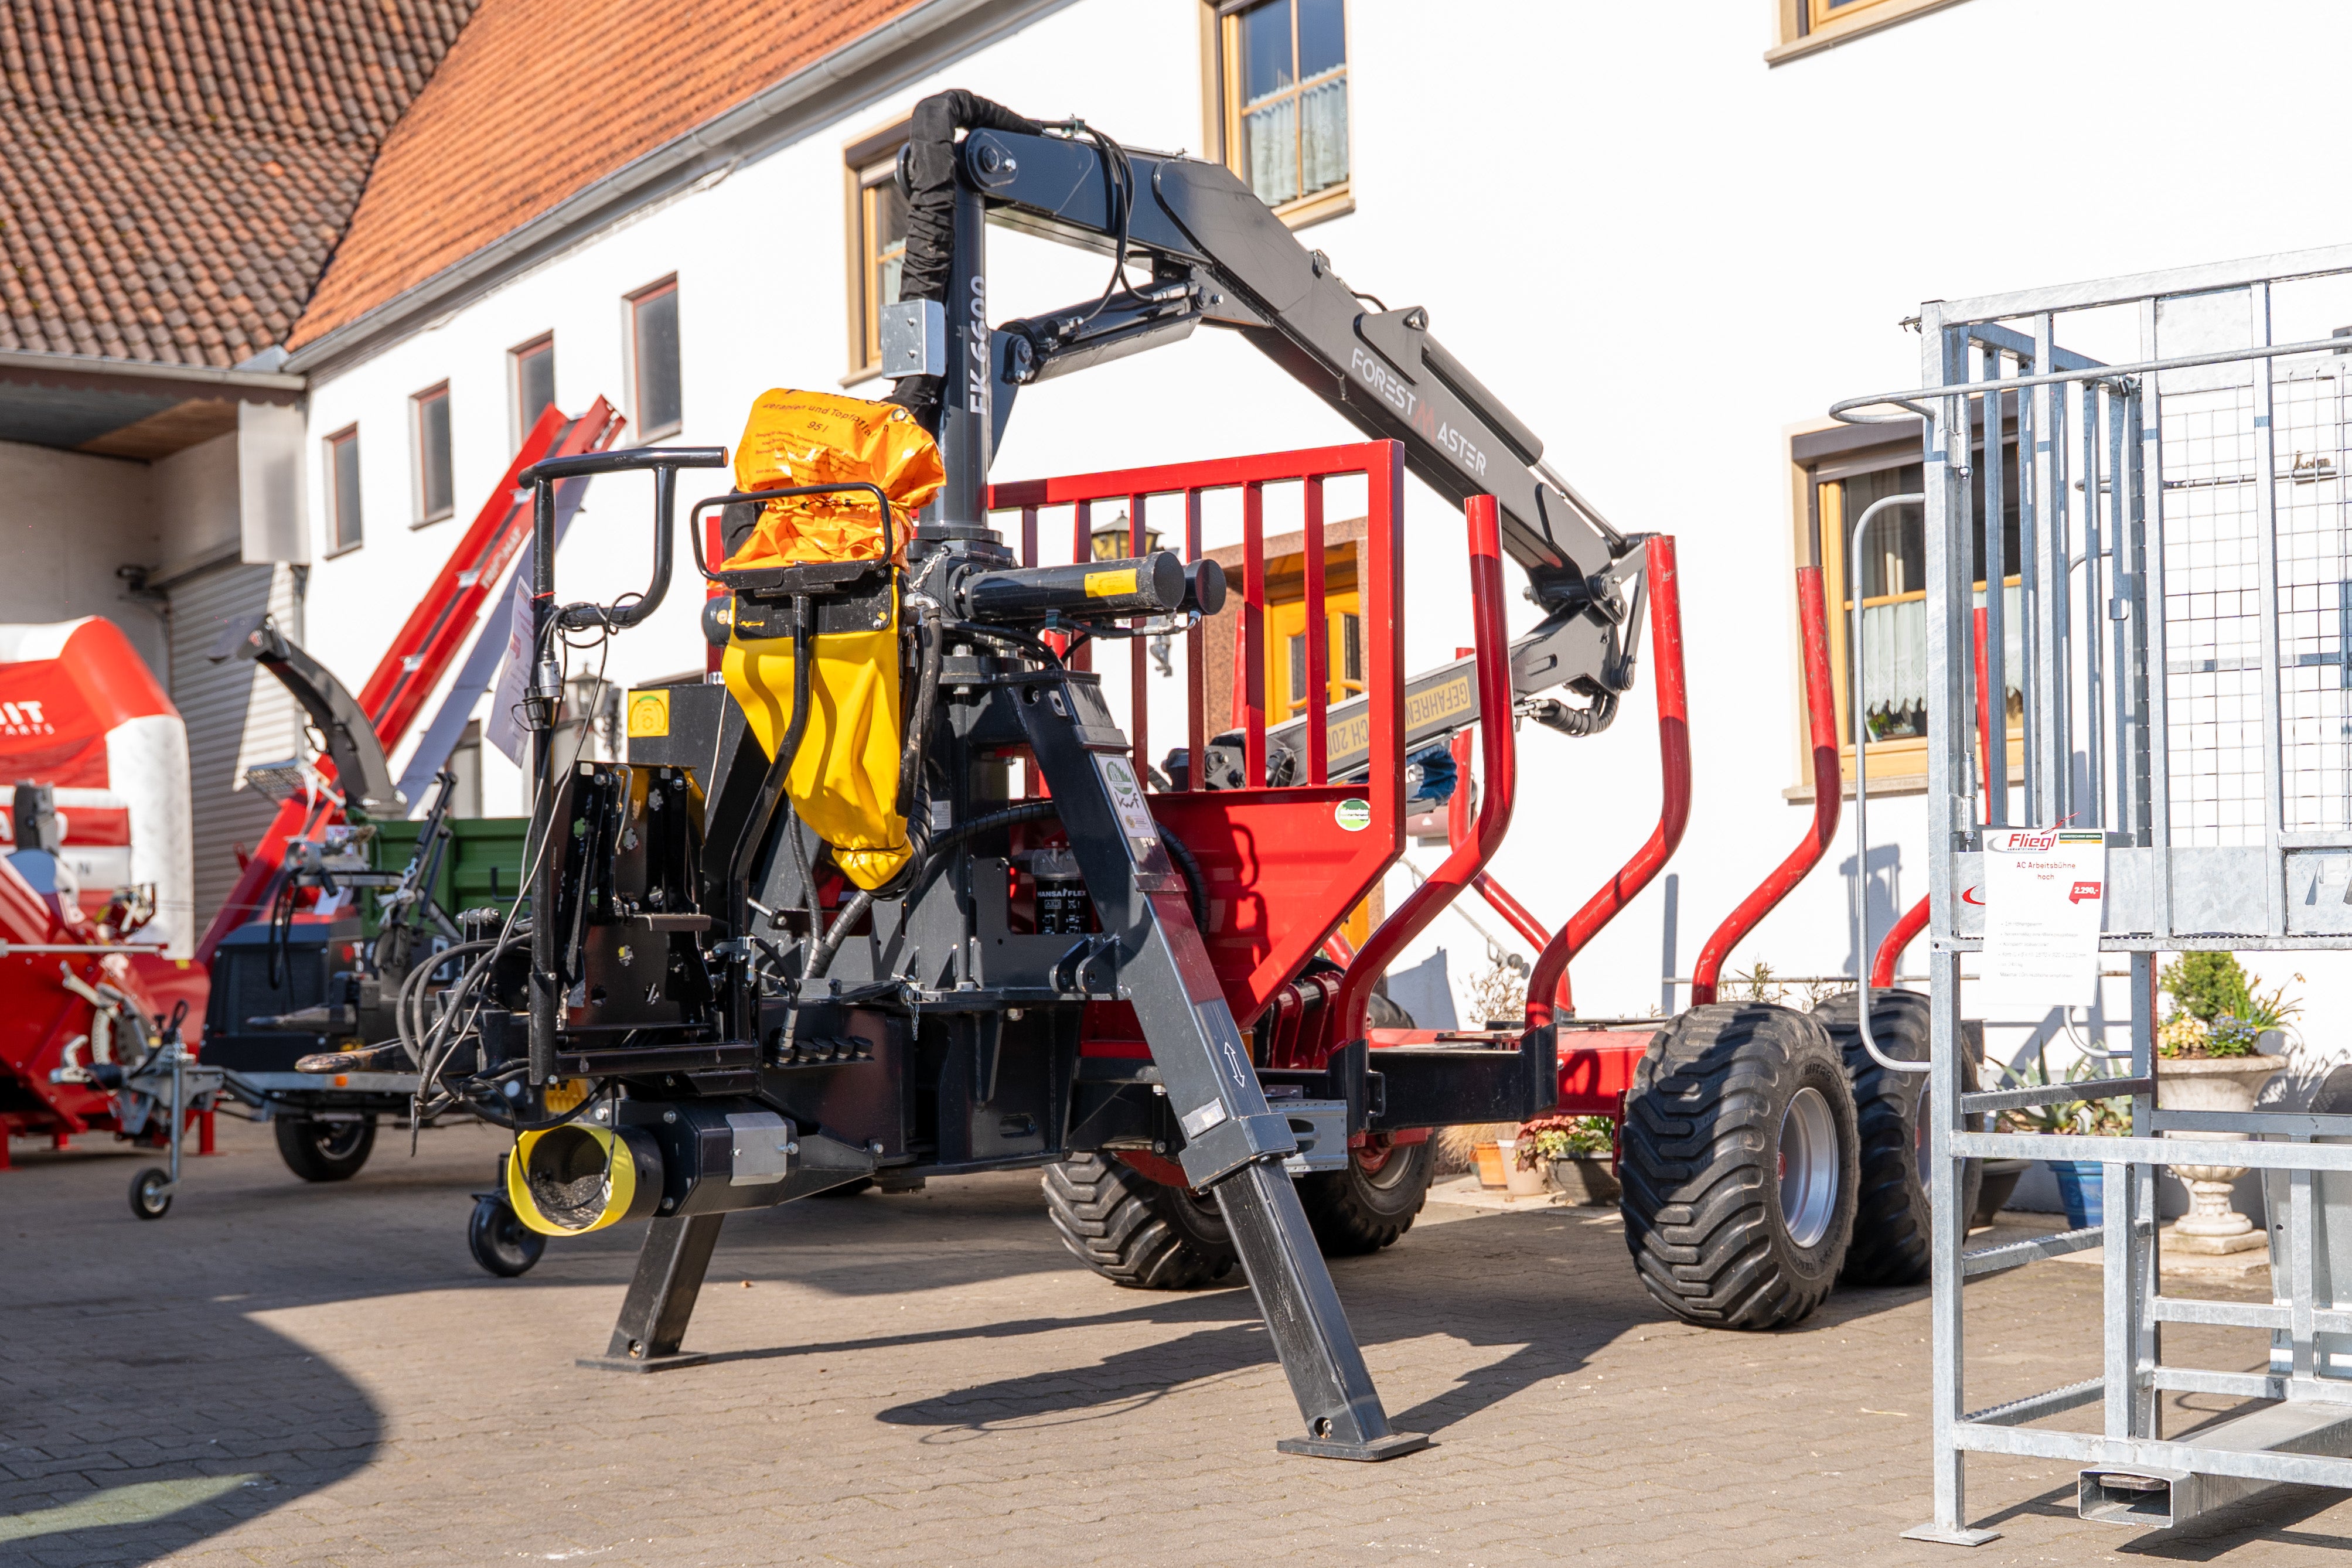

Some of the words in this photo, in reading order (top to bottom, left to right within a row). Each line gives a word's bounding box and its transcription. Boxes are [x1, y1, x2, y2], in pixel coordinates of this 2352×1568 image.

[970, 275, 987, 363] 6600
[970, 369, 987, 415] FK
[809, 405, 830, 414] und
[807, 421, 823, 431] 95
[1114, 791, 1139, 809] kwf
[2009, 833, 2057, 851] Fliegl
[2074, 886, 2099, 895] 2.290,-
